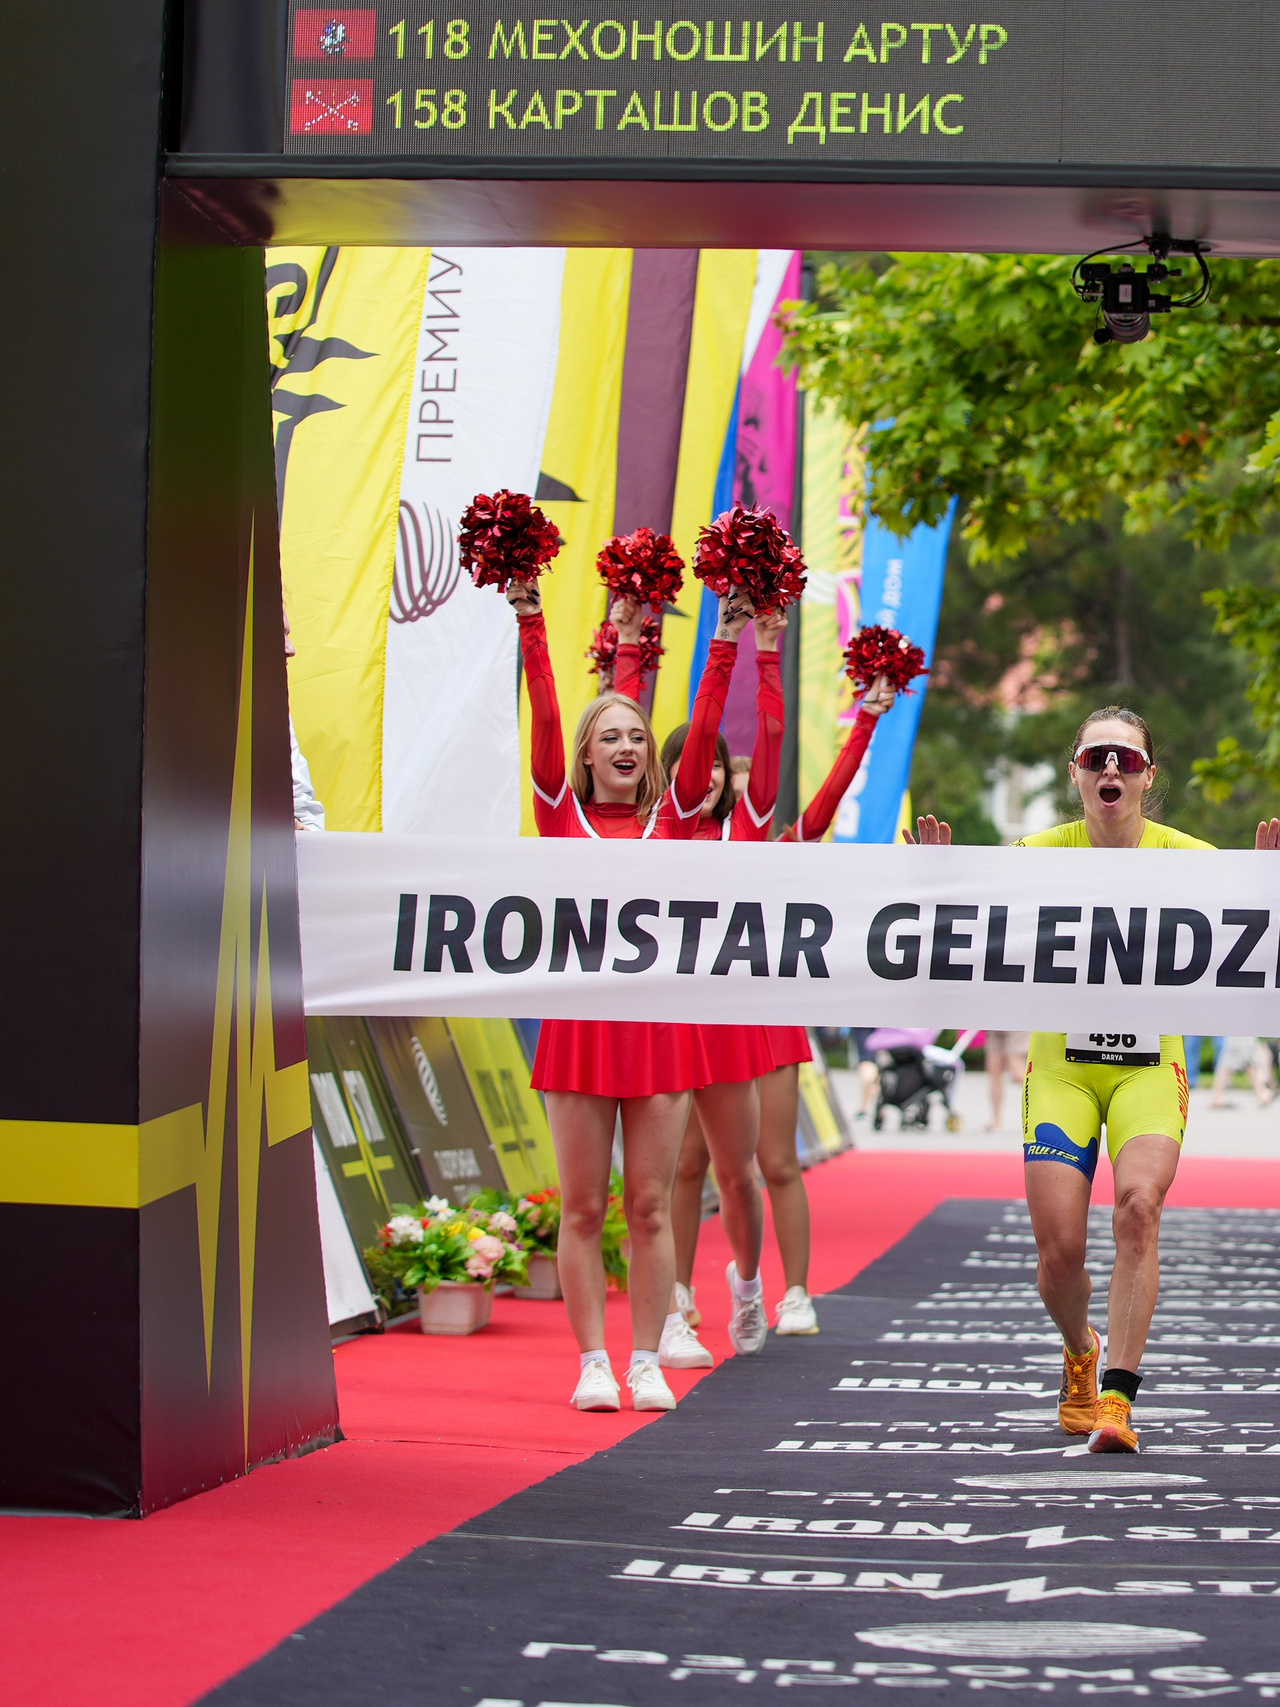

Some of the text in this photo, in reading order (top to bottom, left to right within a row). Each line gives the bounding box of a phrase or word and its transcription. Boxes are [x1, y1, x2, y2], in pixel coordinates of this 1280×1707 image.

[386, 19, 472, 61] 118
[486, 19, 825, 63] МЕХОНОШИН
[841, 23, 1009, 66] АРТУР
[385, 88, 469, 131] 158
[488, 88, 771, 133] КАРТАШОВ
[787, 92, 965, 145] ДЕНИС
[391, 892, 834, 980] IRONSTAR
[1101, 1053, 1124, 1062] DARYA
[837, 1377, 1045, 1391] IRON
[775, 1440, 1015, 1451] IRON
[681, 1511, 972, 1536] IRON
[621, 1558, 944, 1590] IRON
